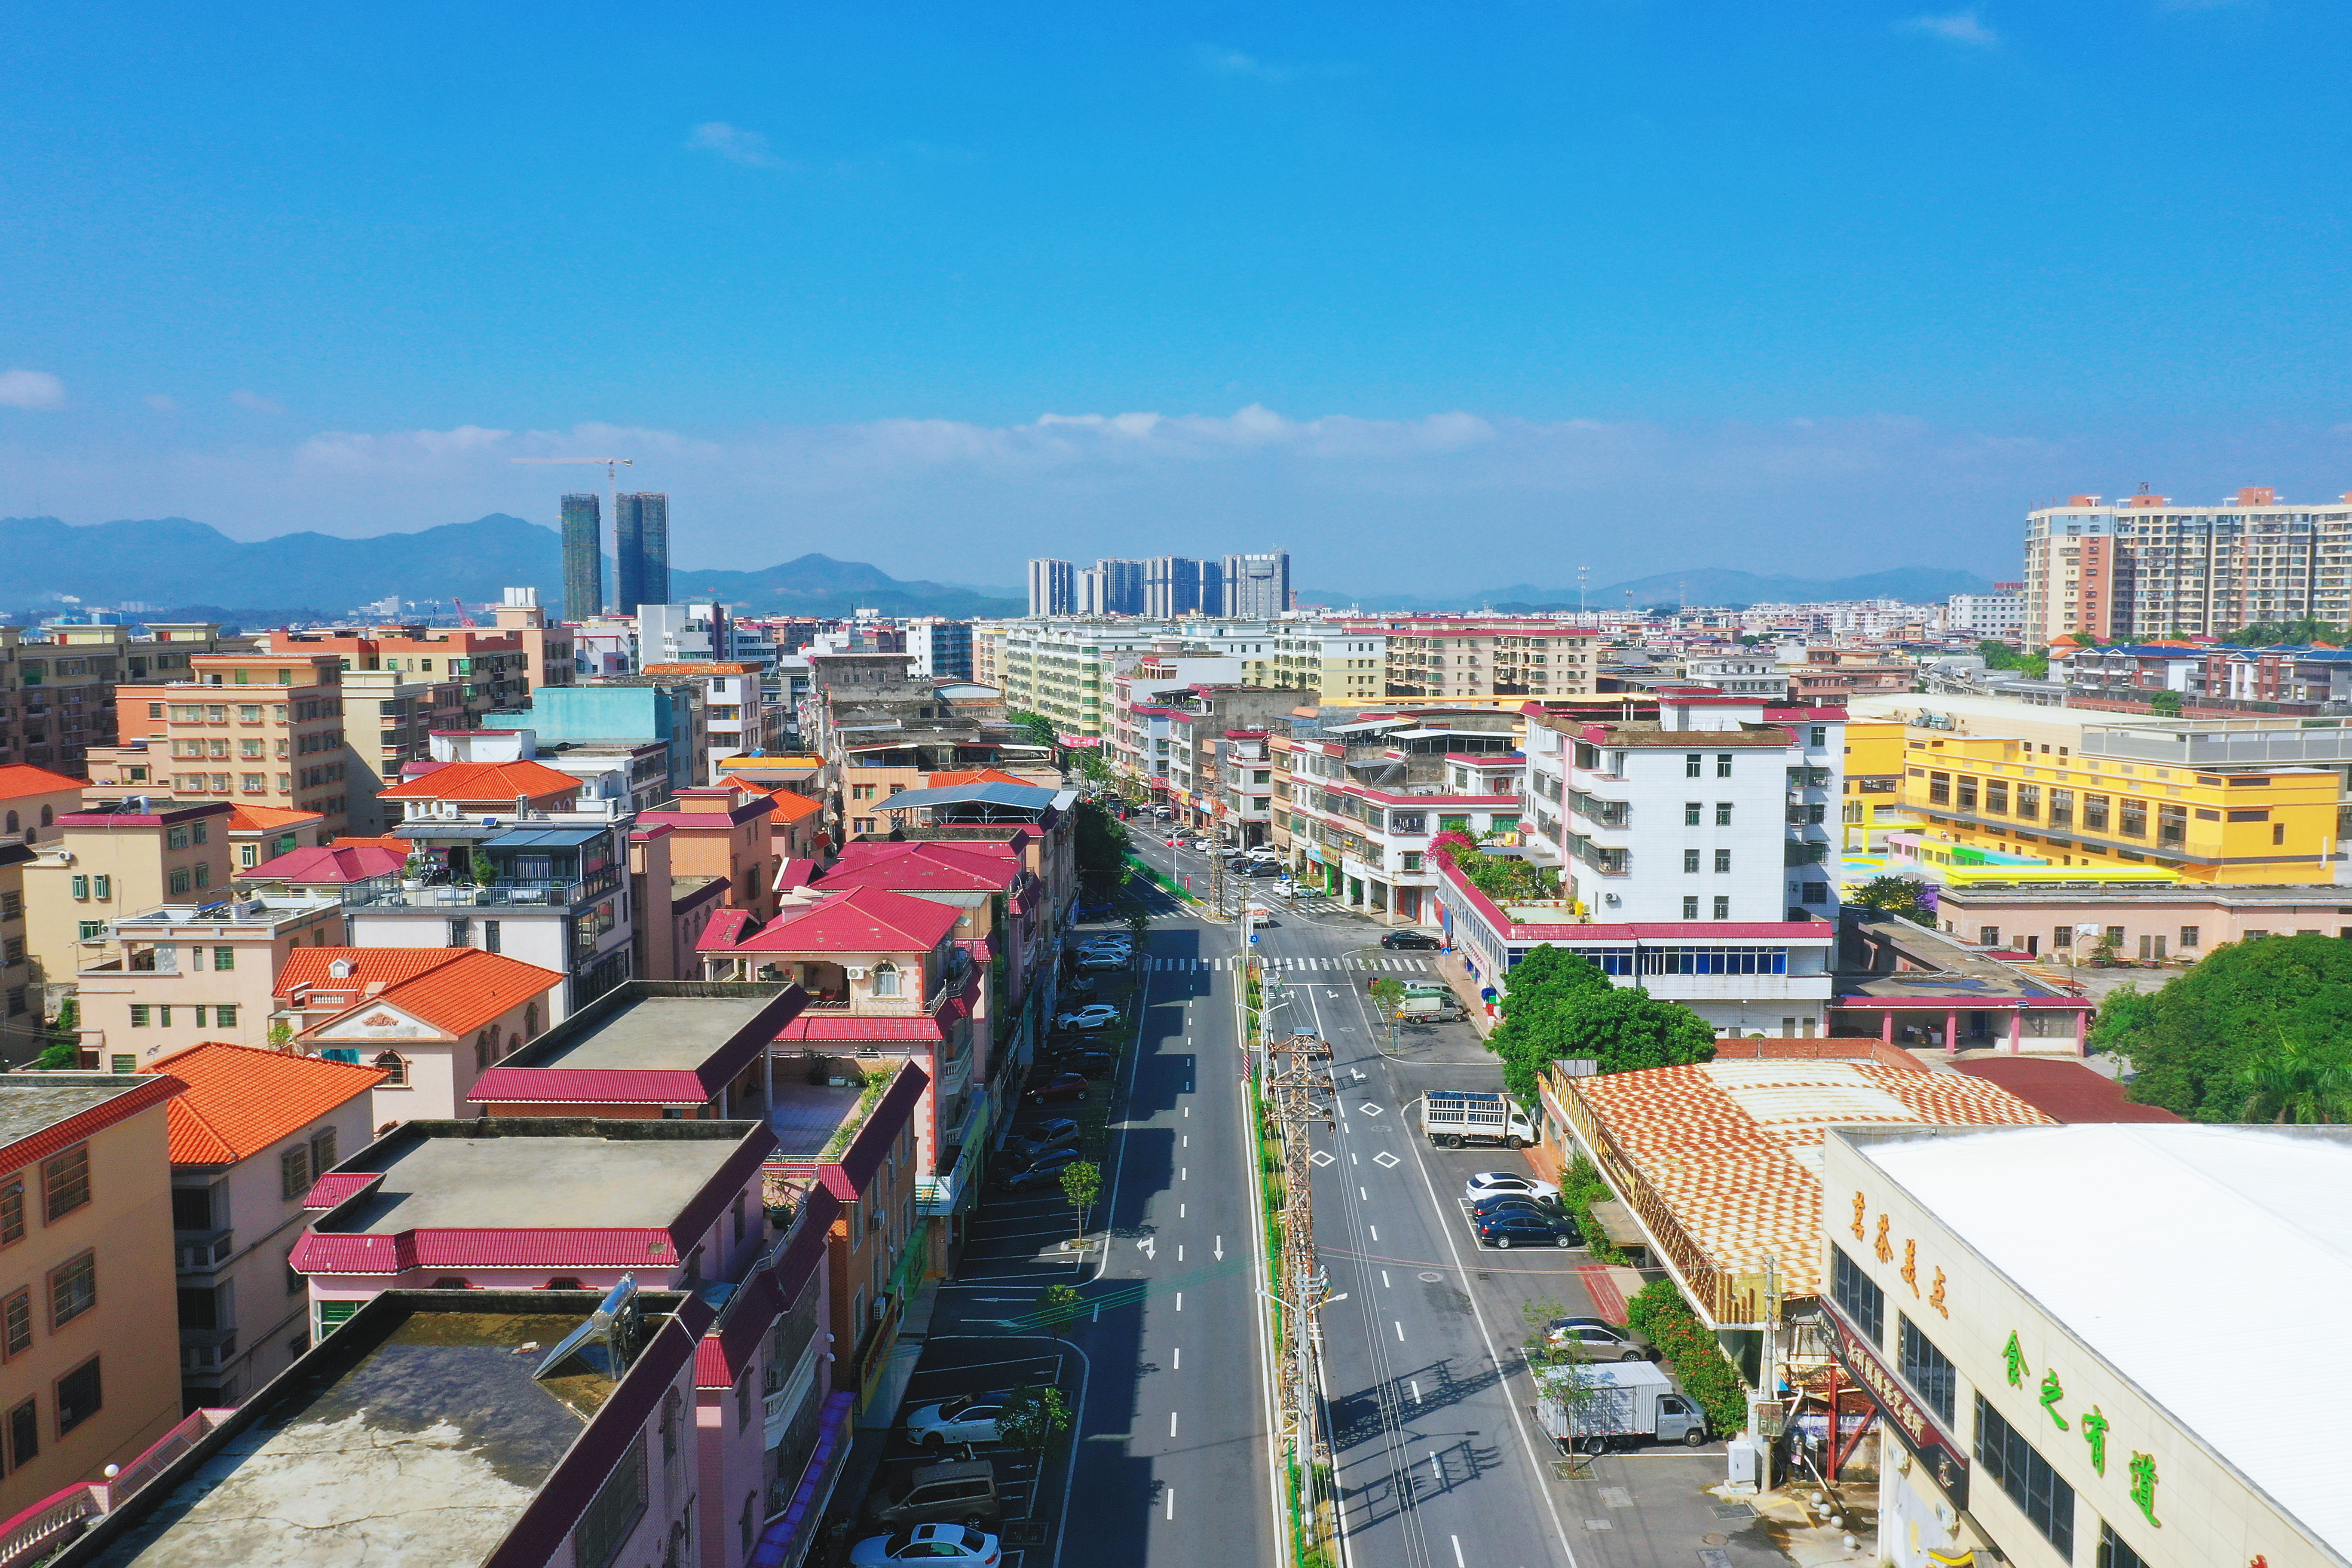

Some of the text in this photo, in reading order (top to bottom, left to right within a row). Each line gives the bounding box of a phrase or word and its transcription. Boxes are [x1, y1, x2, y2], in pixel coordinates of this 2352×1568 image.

[1850, 1190, 1949, 1320] 茗茶美点
[2001, 1329, 2162, 1528] 食之有道
